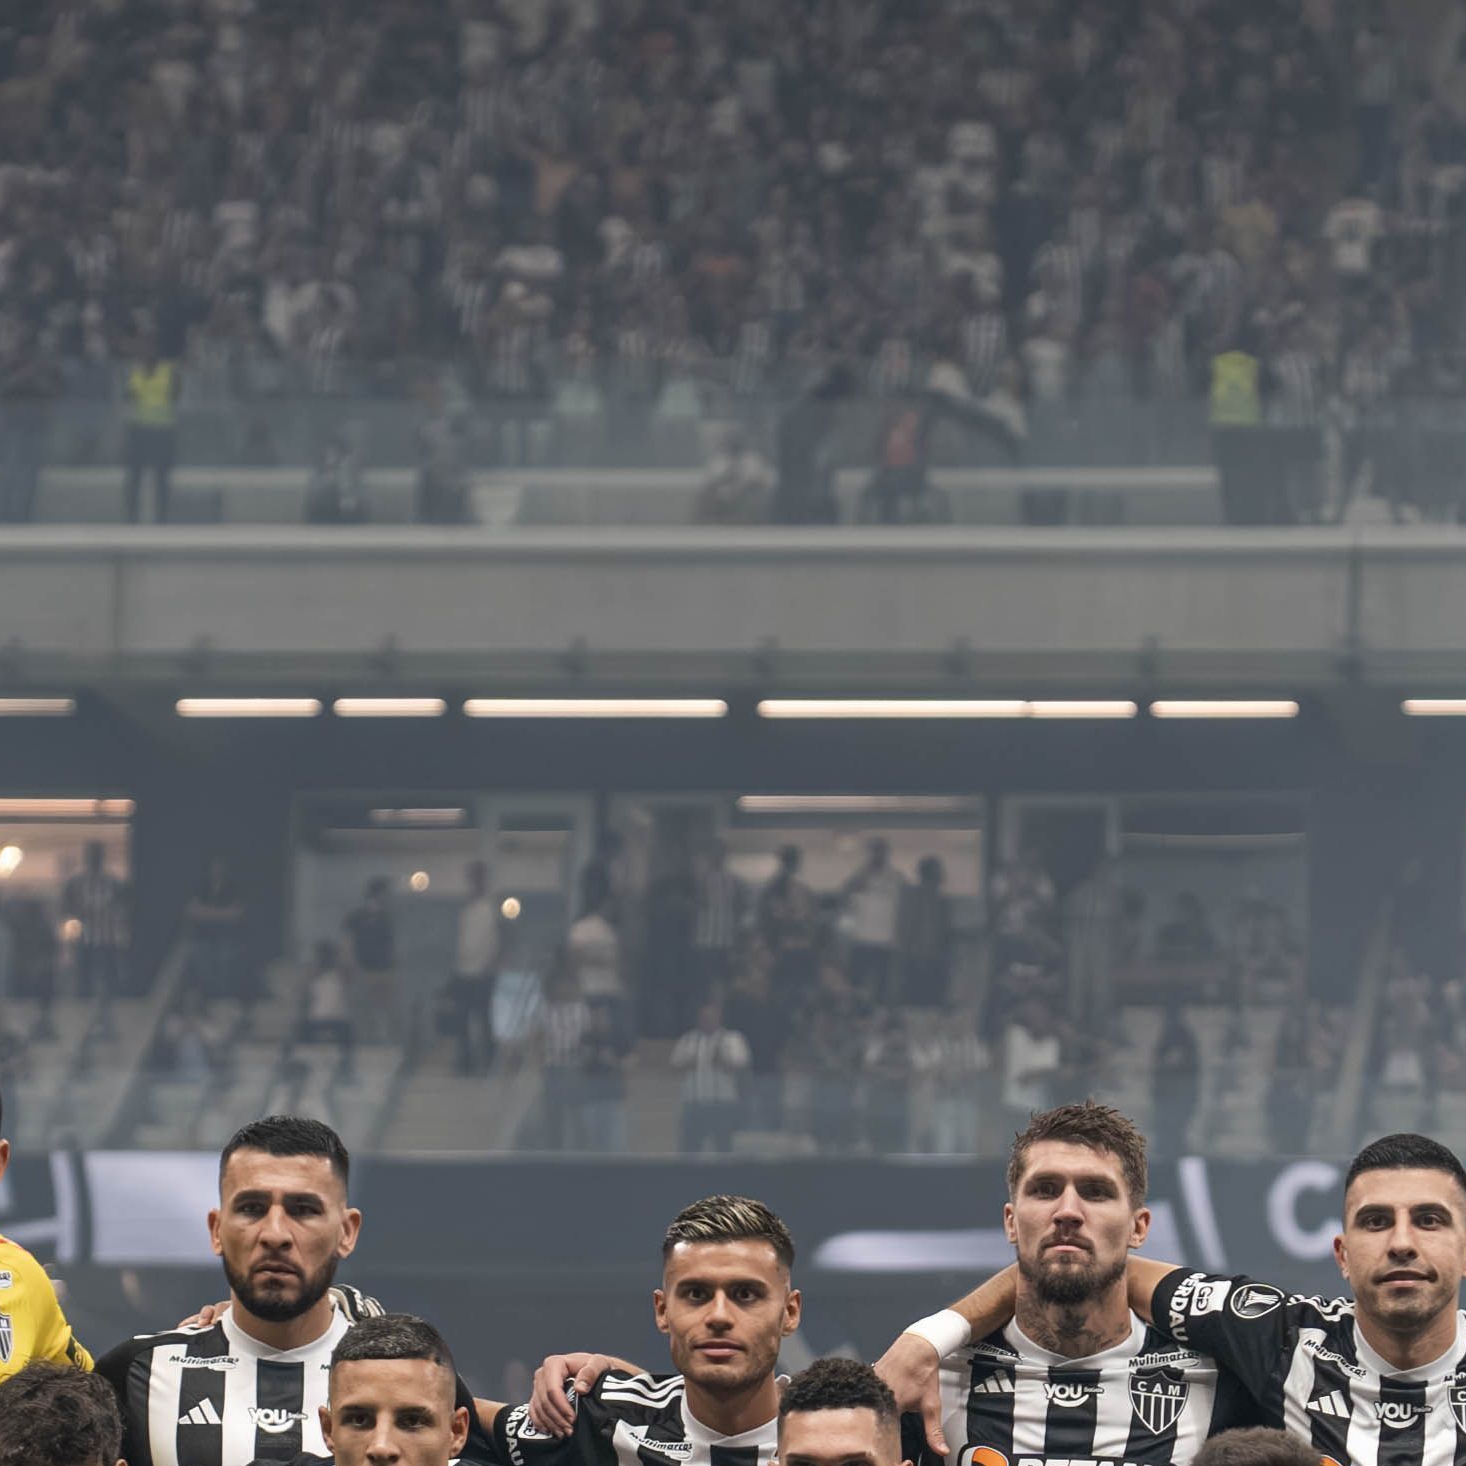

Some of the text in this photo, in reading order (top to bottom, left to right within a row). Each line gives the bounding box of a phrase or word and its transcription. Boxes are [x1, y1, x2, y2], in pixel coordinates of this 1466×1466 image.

[1045, 1384, 1082, 1399] YOU
[1136, 1380, 1182, 1397] CAM
[248, 1408, 286, 1424] YOU
[1374, 1403, 1411, 1420] YOU
